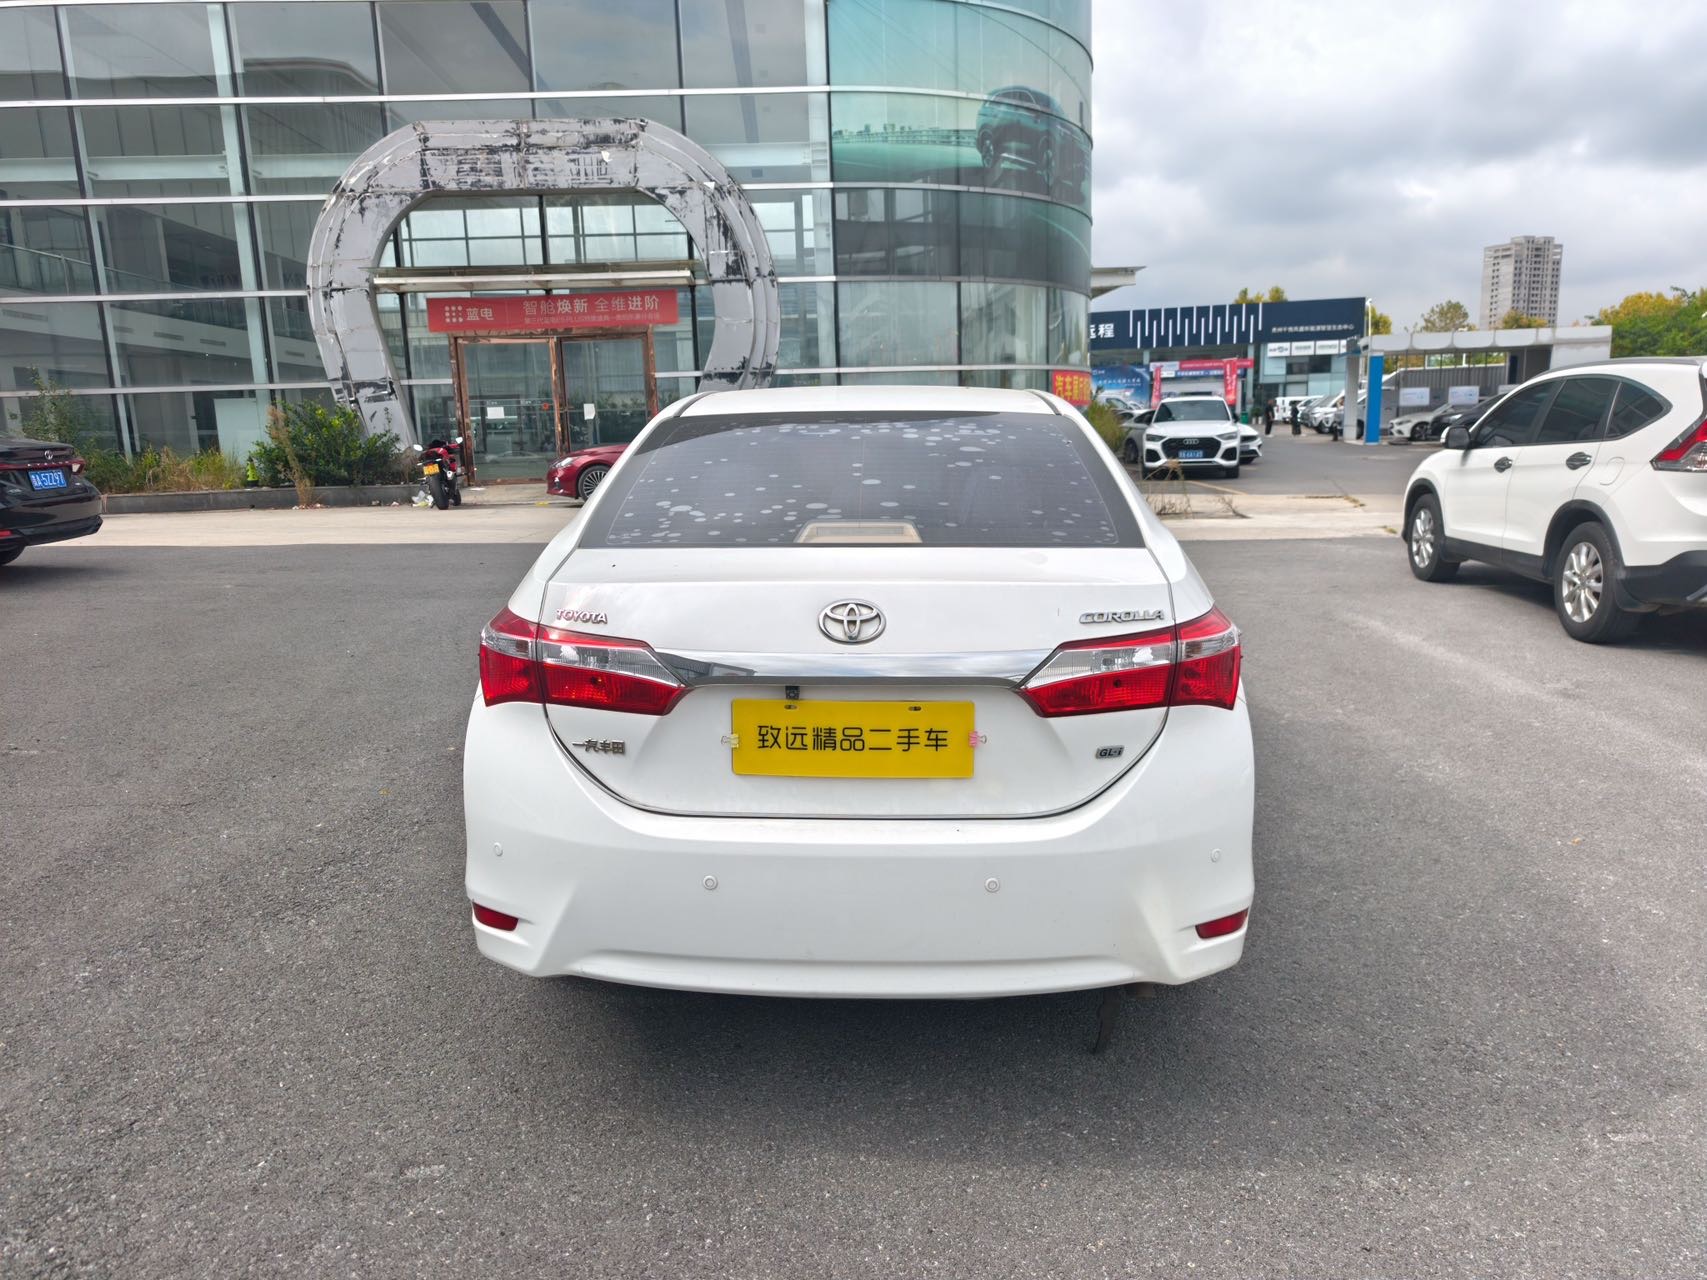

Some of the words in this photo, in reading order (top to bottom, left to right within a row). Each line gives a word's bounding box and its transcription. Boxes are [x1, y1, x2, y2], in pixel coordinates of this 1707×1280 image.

[523, 298, 588, 316] 智舱焕新
[595, 295, 660, 312] 全维进阶
[466, 307, 494, 321] 蓝电
[556, 609, 608, 624] TOYOTA
[1079, 609, 1165, 624] COROLLA
[757, 724, 949, 752] 致远精品二手车
[1098, 746, 1123, 758] GL-i
